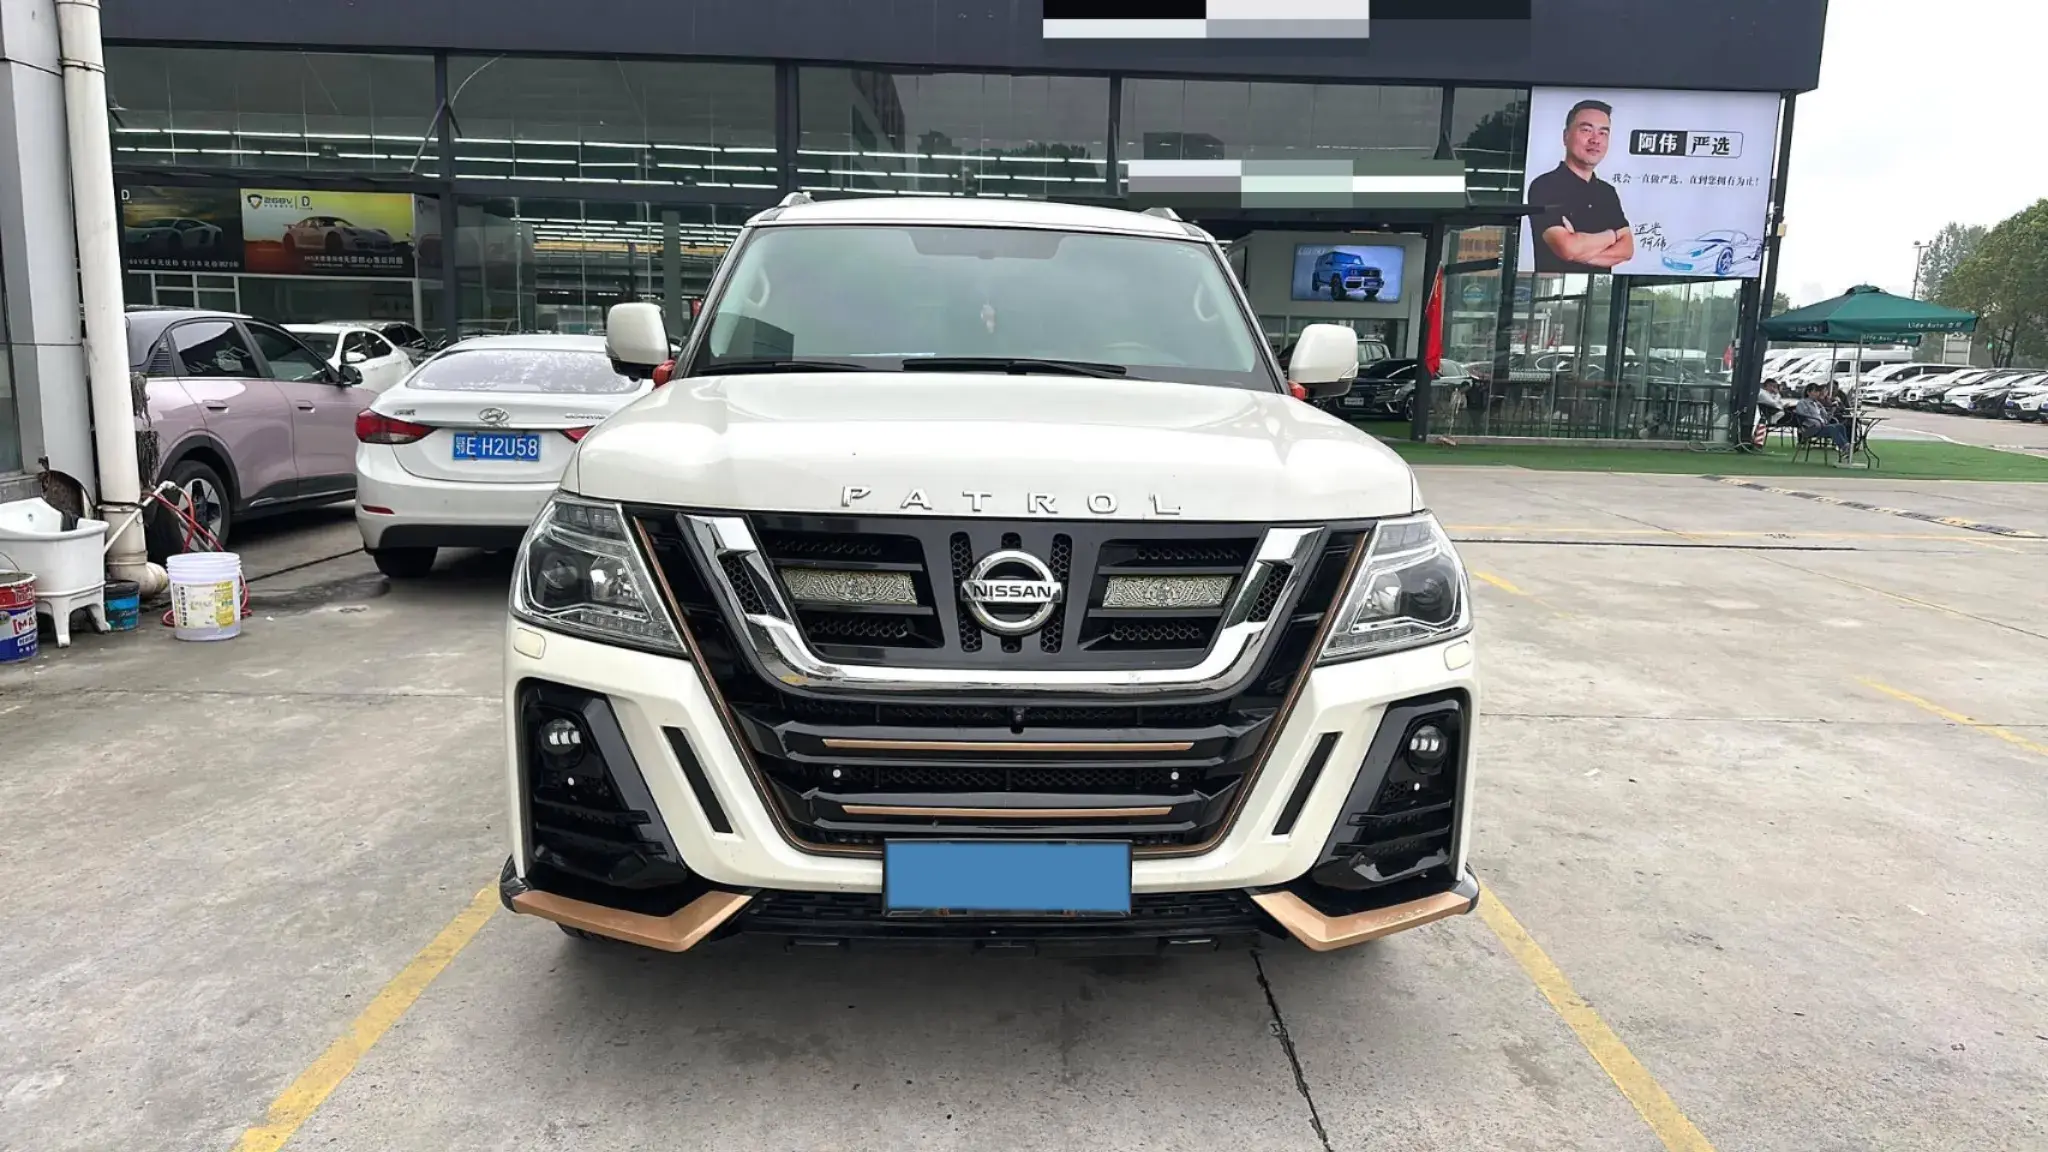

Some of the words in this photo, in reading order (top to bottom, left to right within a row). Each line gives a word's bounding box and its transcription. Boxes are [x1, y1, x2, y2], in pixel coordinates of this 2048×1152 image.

[1638, 132, 1678, 153] 阿伟
[1691, 136, 1731, 155] 严选
[841, 485, 1182, 516] PATROL
[973, 584, 1052, 599] NISSAN
